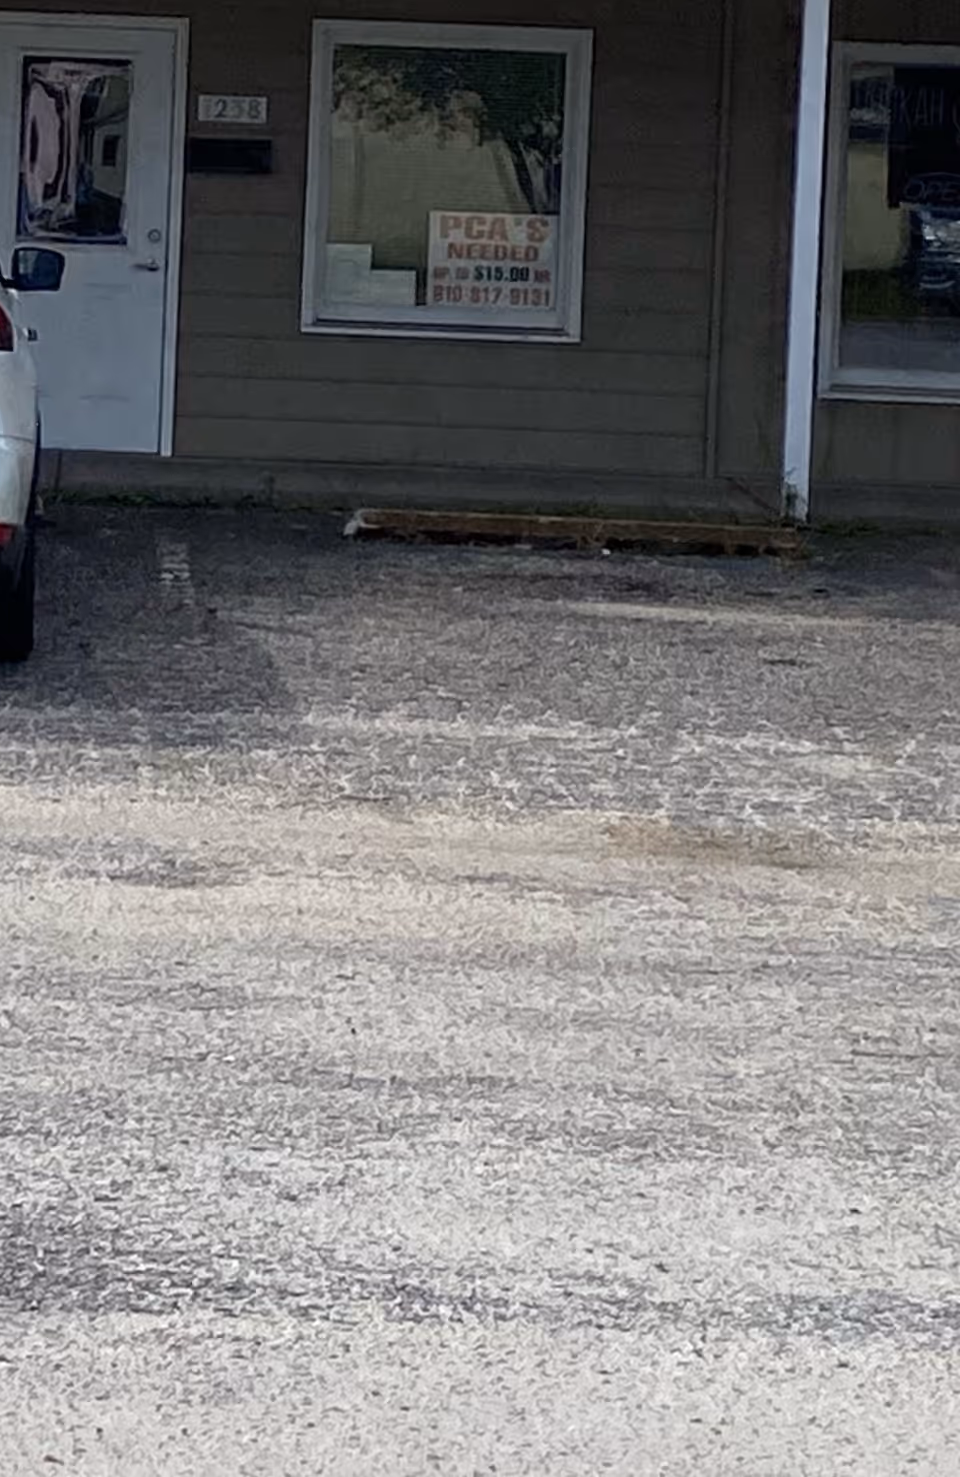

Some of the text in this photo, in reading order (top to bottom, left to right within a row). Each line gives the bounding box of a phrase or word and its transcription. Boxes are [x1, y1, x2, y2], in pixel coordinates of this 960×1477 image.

[440, 214, 550, 243] PCA'S
[447, 242, 540, 262] NEEDED
[474, 265, 530, 283] $15.00
